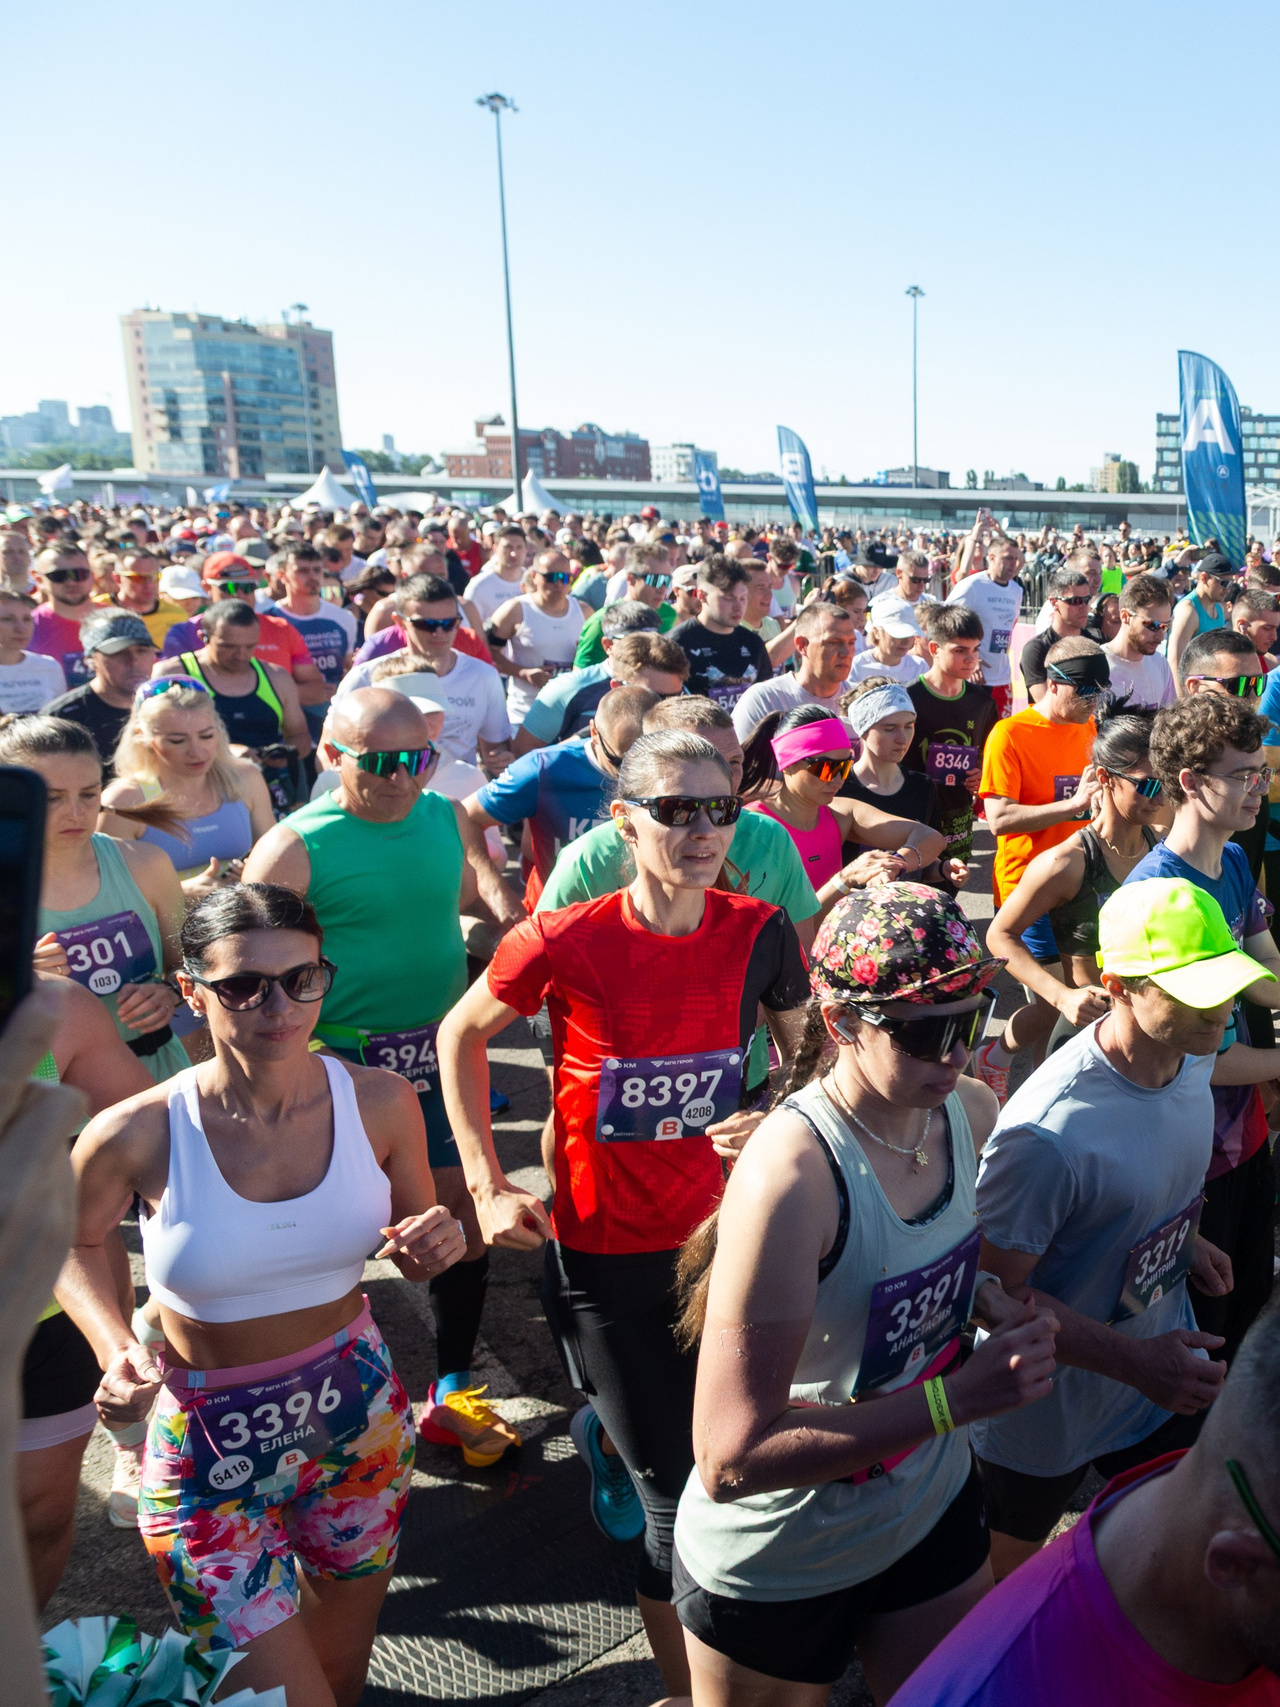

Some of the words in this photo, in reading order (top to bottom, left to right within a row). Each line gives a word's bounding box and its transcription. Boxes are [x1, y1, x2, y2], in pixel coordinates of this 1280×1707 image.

[1182, 399, 1236, 455] A
[935, 752, 970, 770] 8346
[94, 975, 118, 988] 1031
[621, 1069, 723, 1108] 8397
[685, 1105, 712, 1119] 4208
[1135, 1219, 1190, 1285] 3319
[1140, 1254, 1177, 1296] ДМИТРИЙ
[886, 1261, 966, 1342] 3391
[889, 1304, 953, 1357] АНАСТАСИЯ
[214, 1395, 230, 1404] КМ
[219, 1376, 341, 1450] 3396
[260, 1425, 316, 1454] ЕЛЕНА
[213, 1460, 250, 1486] 5418
